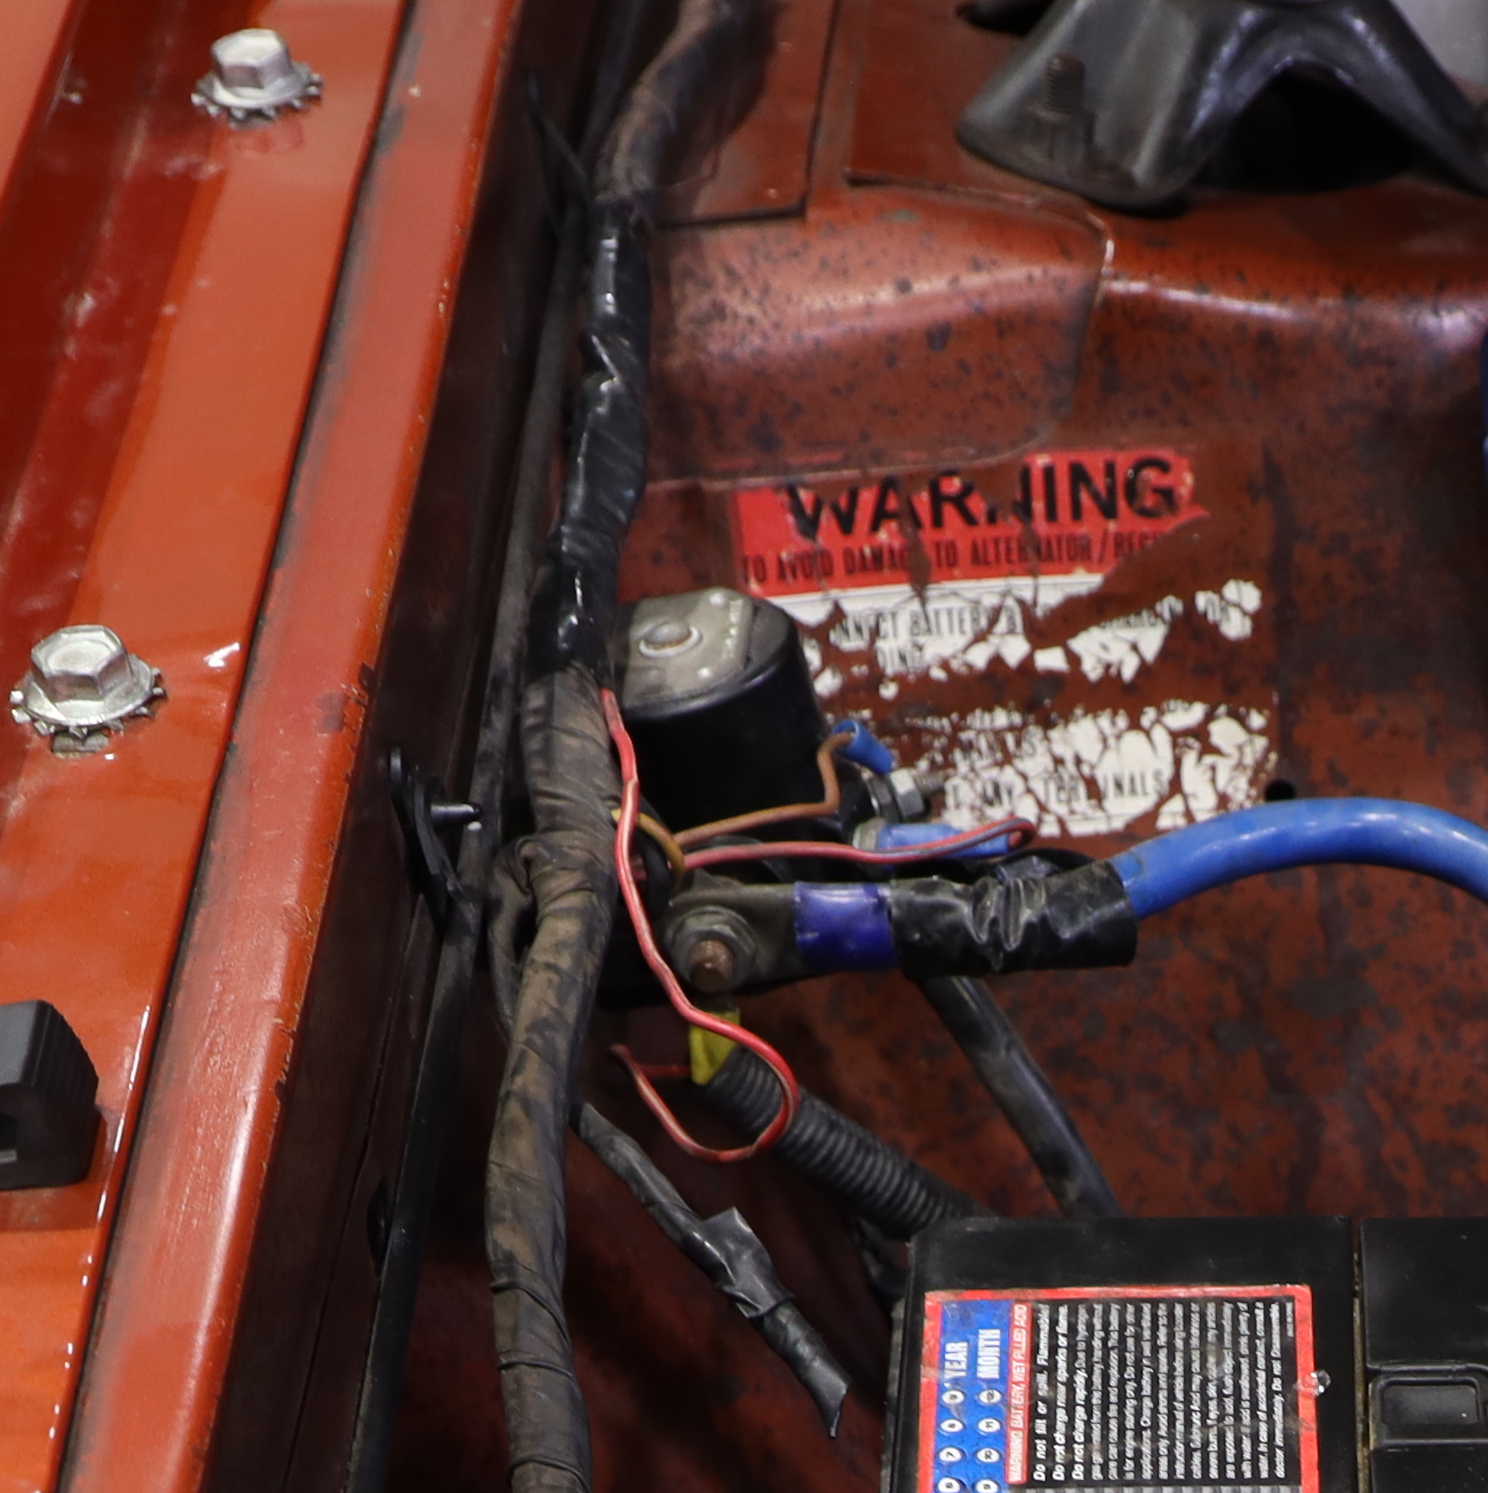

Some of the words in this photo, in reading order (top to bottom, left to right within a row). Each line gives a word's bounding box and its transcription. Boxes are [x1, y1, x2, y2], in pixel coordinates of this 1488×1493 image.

[935, 540, 959, 569] TO
[1014, 1303, 1027, 1327] ACID
[944, 1341, 968, 1380] YEAR
[977, 1328, 1001, 1380] MONTH
[1012, 1359, 1025, 1381] WET
[1037, 1401, 1048, 1414] or
[1035, 1439, 1047, 1459] not
[1073, 1444, 1085, 1463] not
[1033, 1464, 1046, 1481] Do
[1052, 1464, 1065, 1481] Do
[1071, 1464, 1085, 1480] Do
